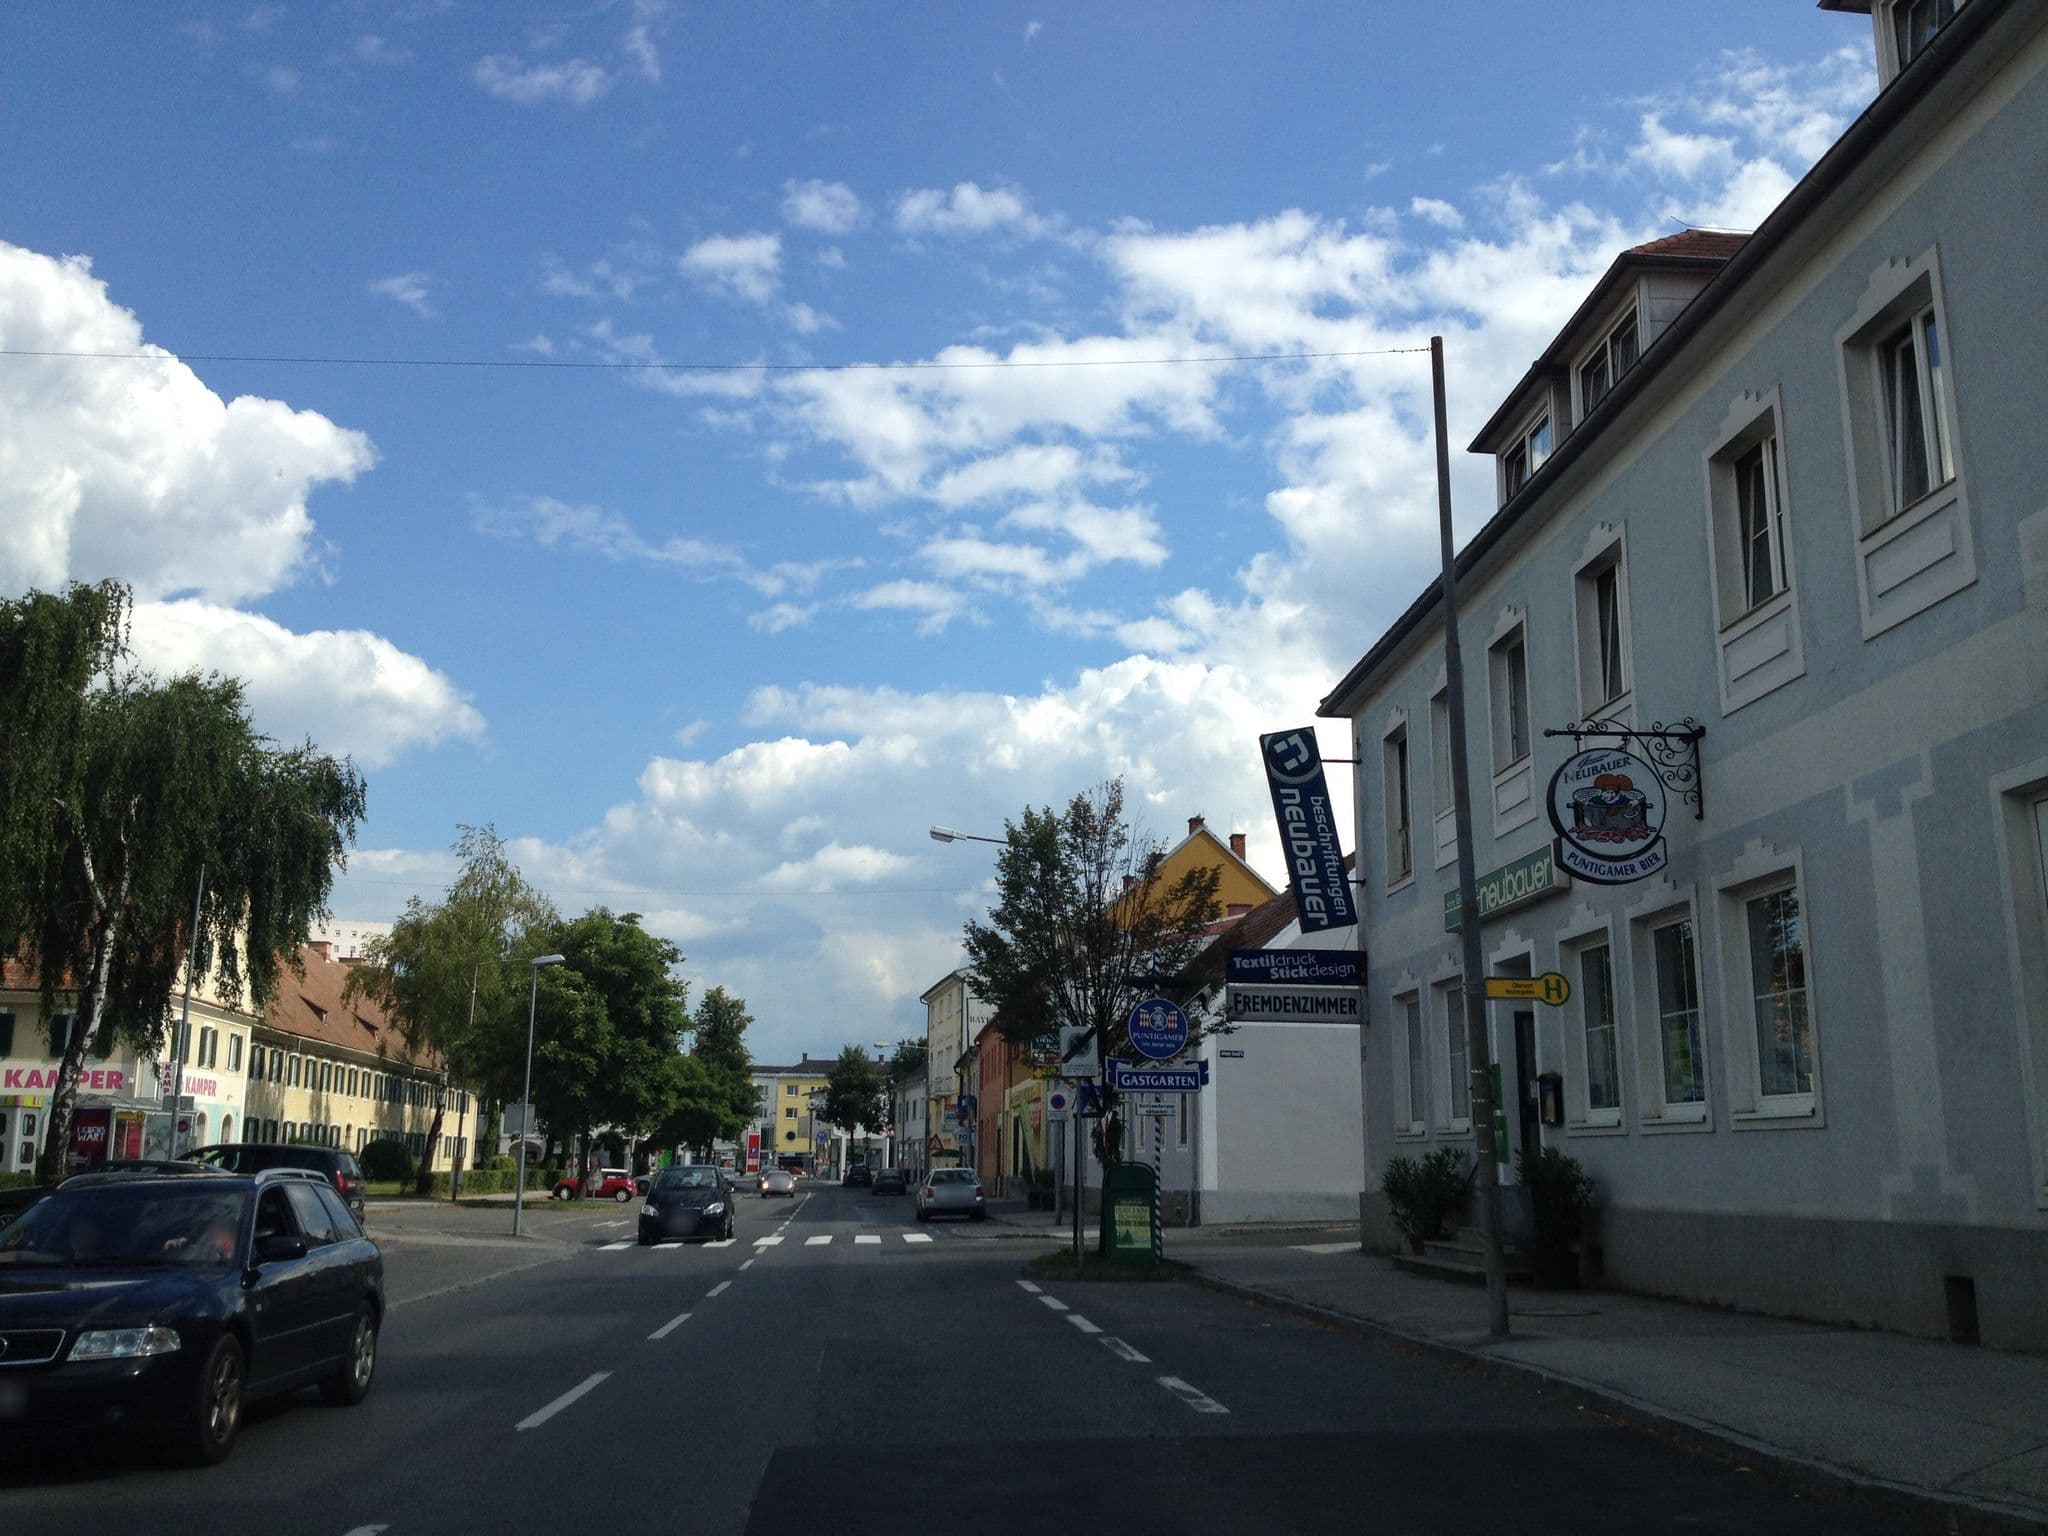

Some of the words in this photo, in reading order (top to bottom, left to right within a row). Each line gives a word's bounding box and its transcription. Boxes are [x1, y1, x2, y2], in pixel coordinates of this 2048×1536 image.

[1564, 756, 1632, 783] NEUBAUER
[1279, 787, 1329, 927] neubauer
[1310, 796, 1349, 917] beschriftungen
[1566, 852, 1638, 877] PUNTIGAMER
[1639, 852, 1662, 871] BIER
[1479, 855, 1551, 912] neubauer
[1233, 953, 1317, 969] Textildruck
[1270, 964, 1357, 979] Stickdesign
[1233, 993, 1358, 1015] FREMDENZIMMER
[1132, 1032, 1185, 1042] PUNTIGAMER
[185, 1075, 217, 1097] KAMPER
[1121, 1074, 1196, 1087] GASTGARTEN
